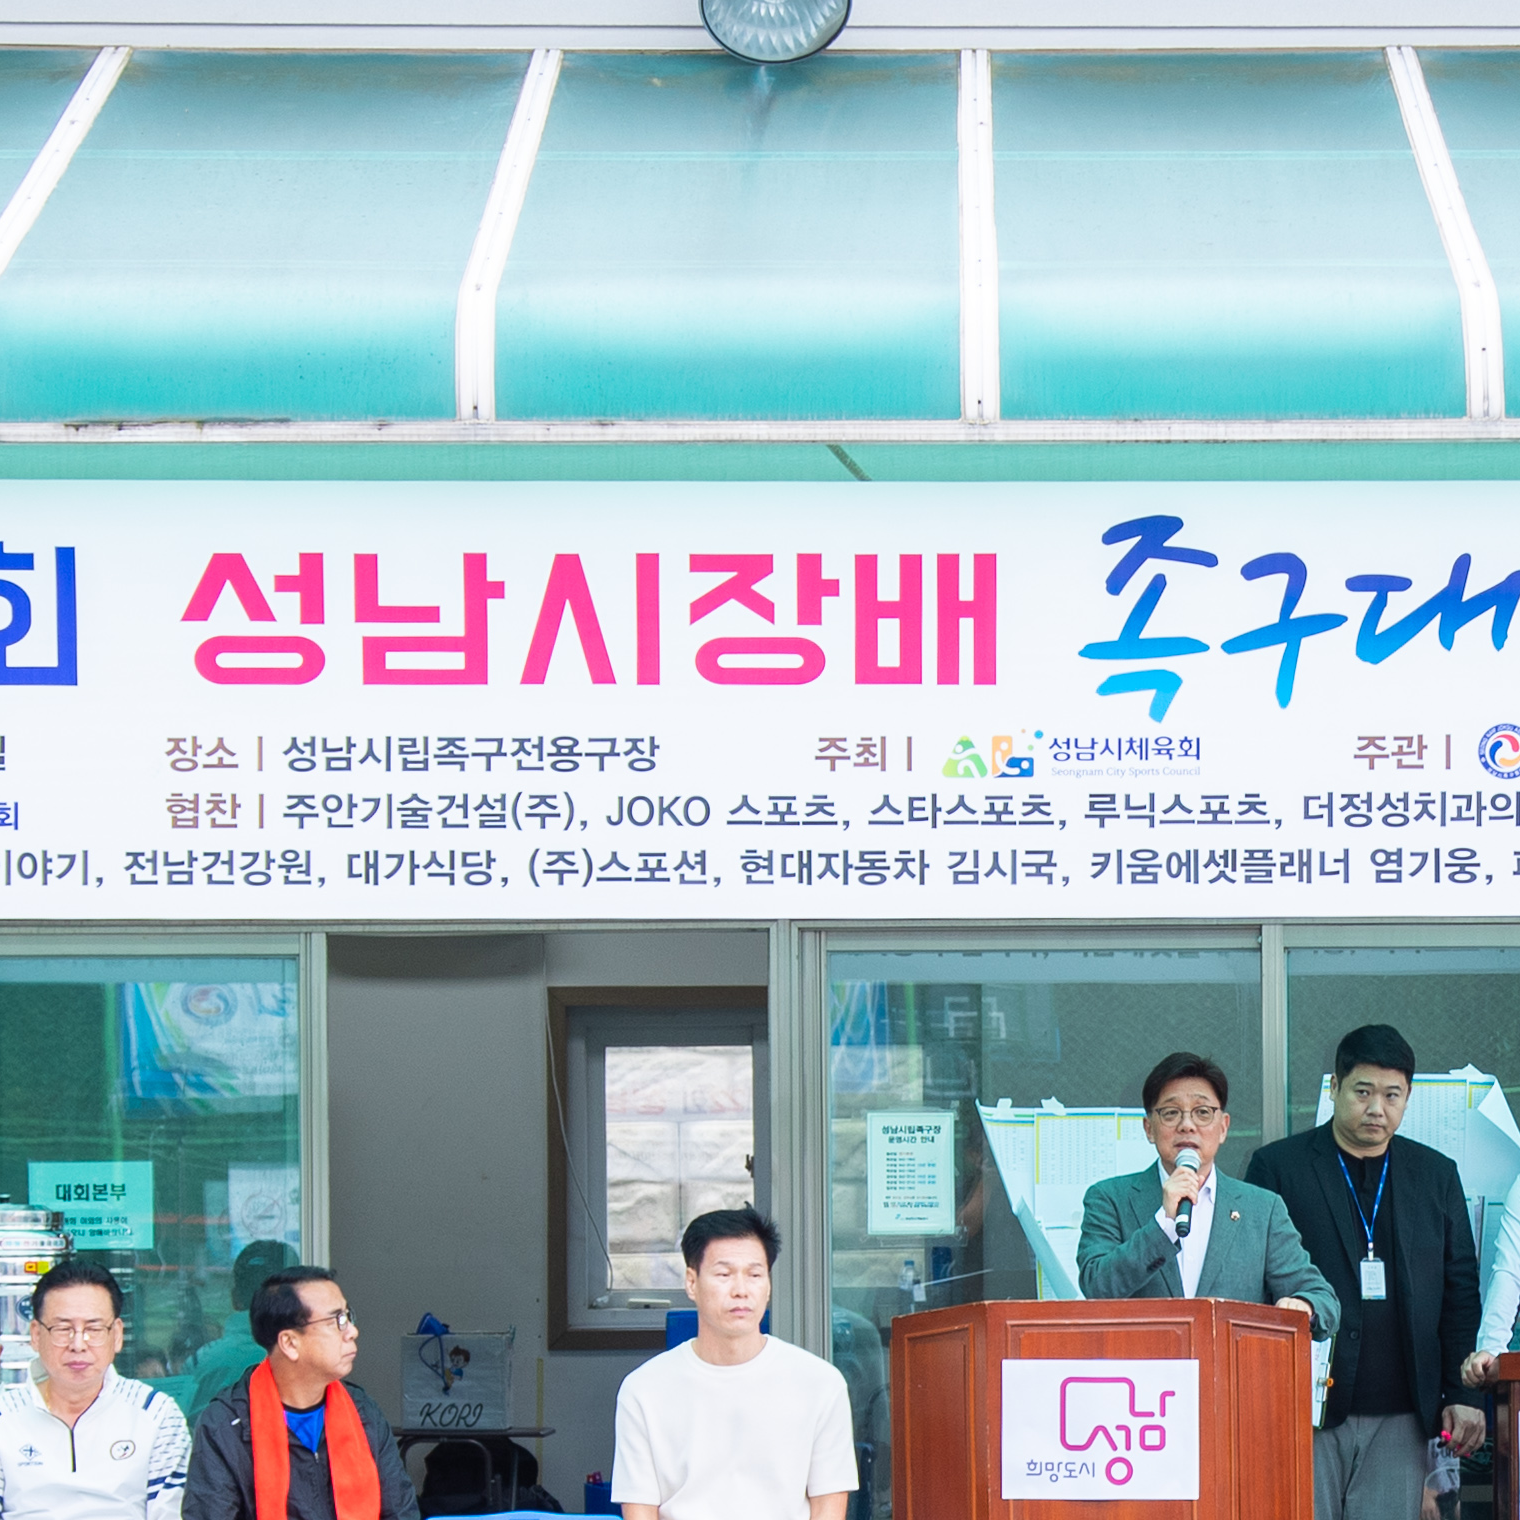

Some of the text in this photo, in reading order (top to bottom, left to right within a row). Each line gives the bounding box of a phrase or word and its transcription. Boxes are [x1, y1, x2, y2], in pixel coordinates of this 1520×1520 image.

[181, 552, 997, 685] 성남시장배
[165, 736, 660, 772] 장소 성남시립족구전용구장
[815, 736, 1200, 772] 주최 성남시체육회
[1354, 734, 1428, 770] 주관
[1051, 766, 1201, 778] Seongnam City Sports Council
[166, 793, 241, 829] 협찬
[283, 792, 587, 831] 주안기술건설(주),
[606, 796, 710, 826] JOKO
[727, 795, 849, 830] 스포츠,
[868, 793, 1066, 830] 스타스포츠,
[1084, 793, 1282, 829] 루닉스포츠,
[124, 849, 325, 887] 전남건강원,
[348, 850, 508, 887] 대가식당,
[529, 848, 721, 887] (주)스포션,
[740, 850, 930, 885] 현대자동차
[948, 849, 1069, 887] 김시국,
[1091, 848, 1349, 884] 키움에셋플래너
[1370, 848, 1493, 885] 염기웅,
[55, 1183, 127, 1202] 대회본부
[420, 1403, 483, 1428] KORI
[1026, 1459, 1095, 1483] 희망도시
